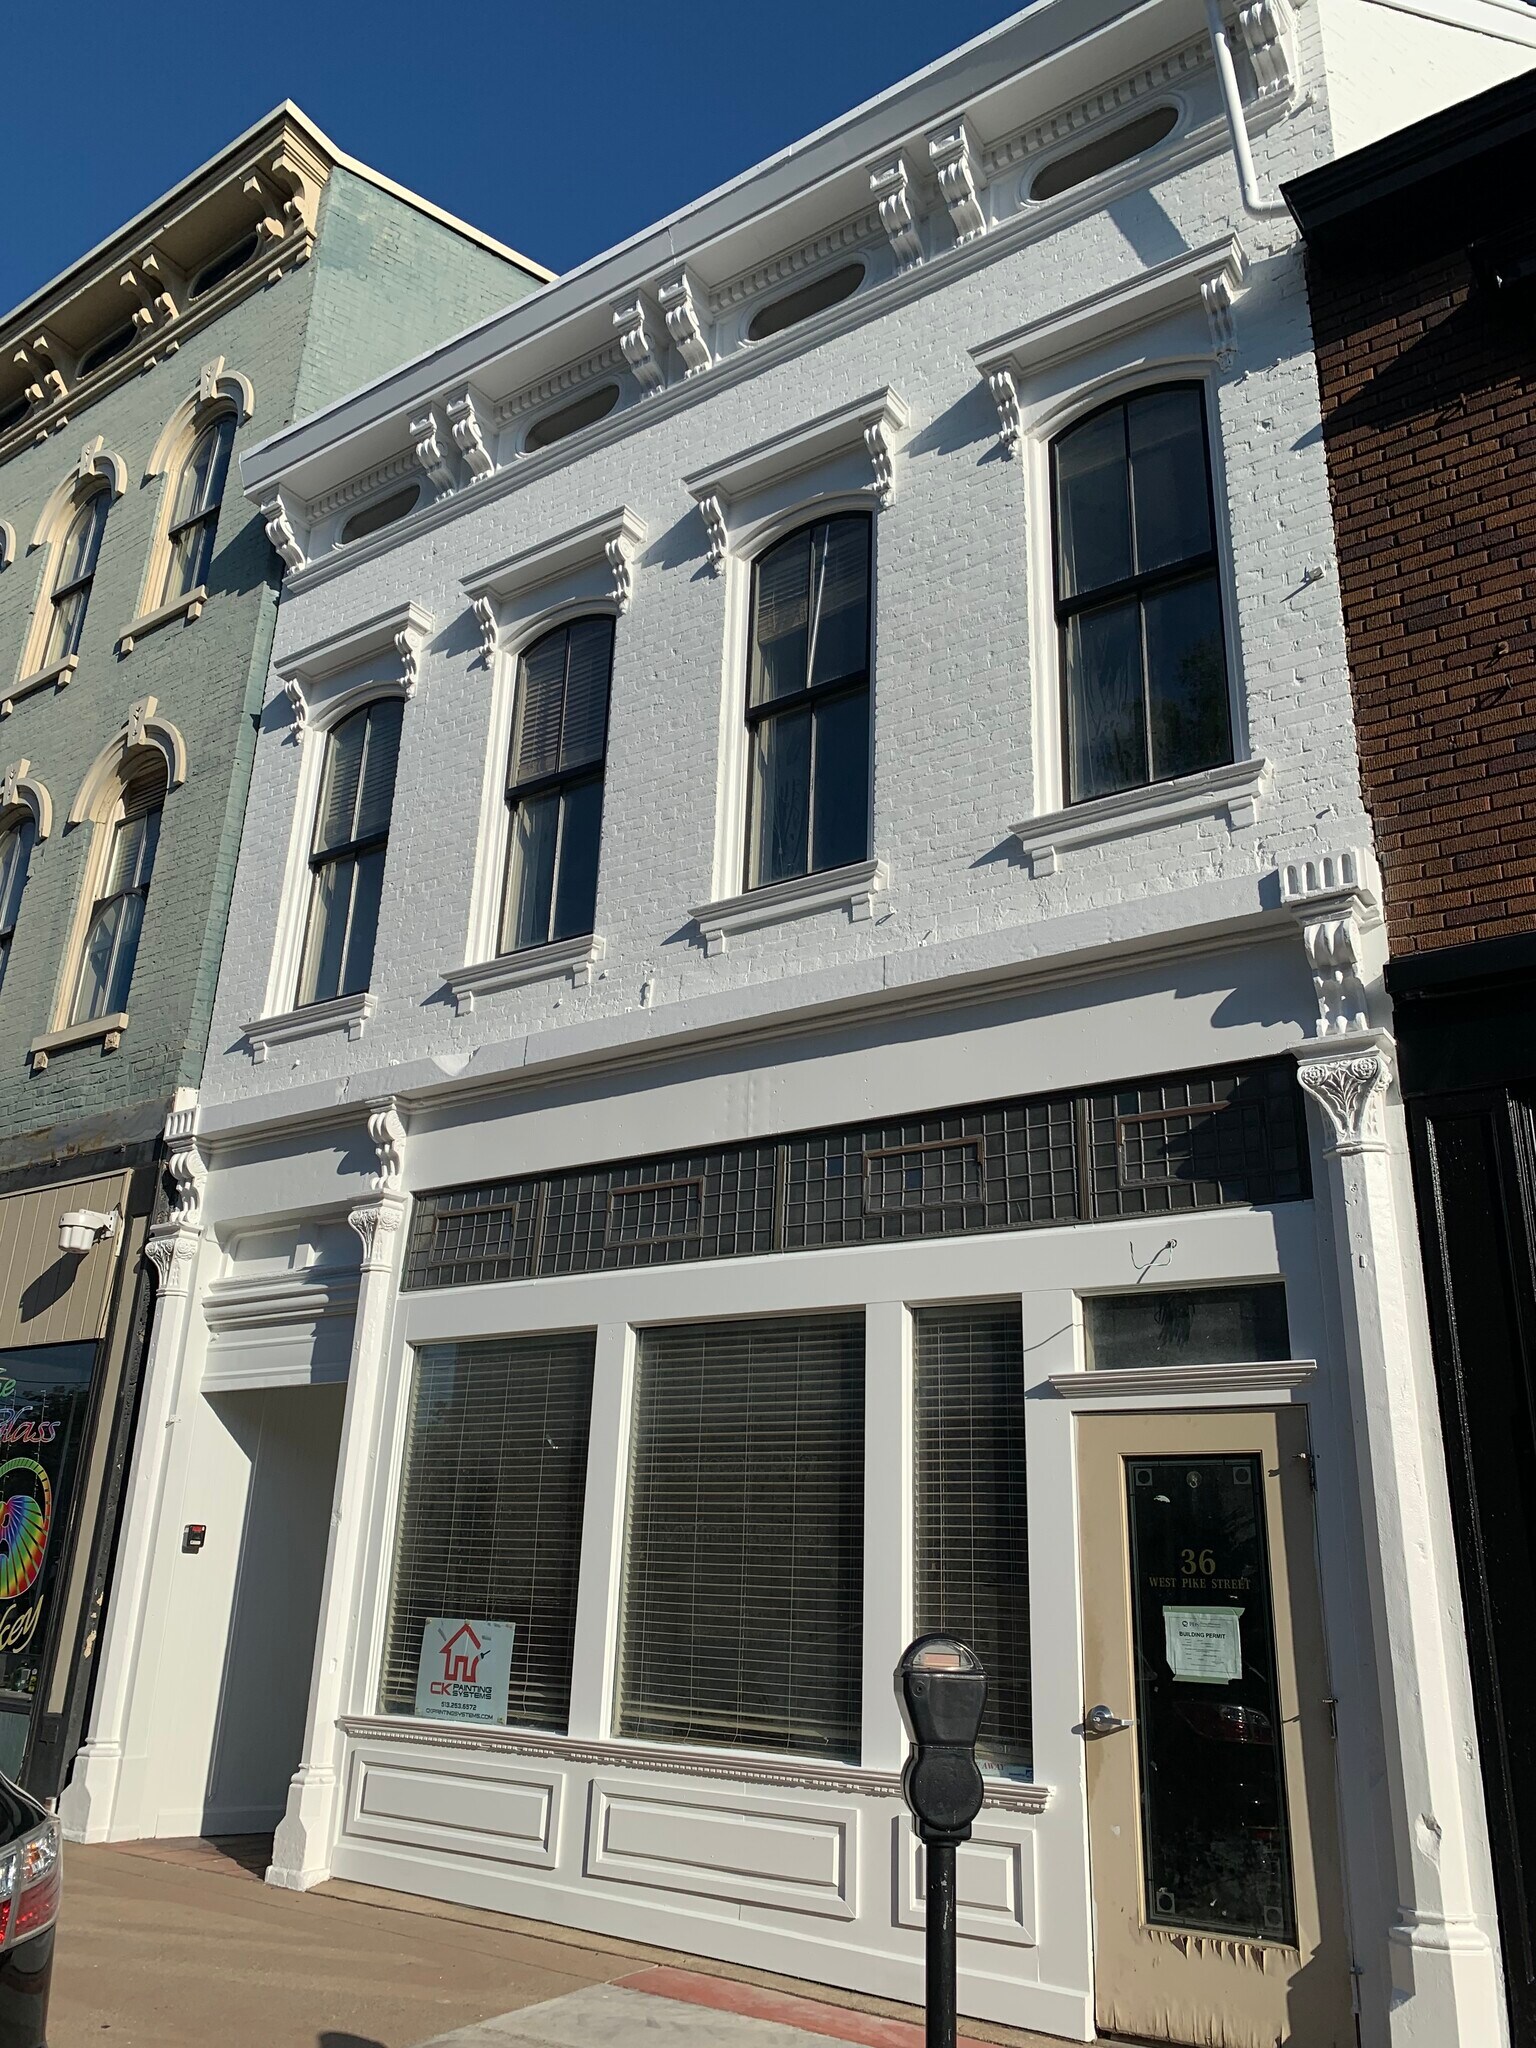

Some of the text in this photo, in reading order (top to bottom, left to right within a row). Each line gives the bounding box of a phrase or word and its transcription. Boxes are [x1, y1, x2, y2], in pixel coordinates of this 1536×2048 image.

[1181, 1548, 1216, 1575] 36
[1149, 1577, 1251, 1590] WEST PIKE STREET
[430, 1682, 492, 1696] CK PAINTING
[452, 1690, 492, 1700] SYSTEMS
